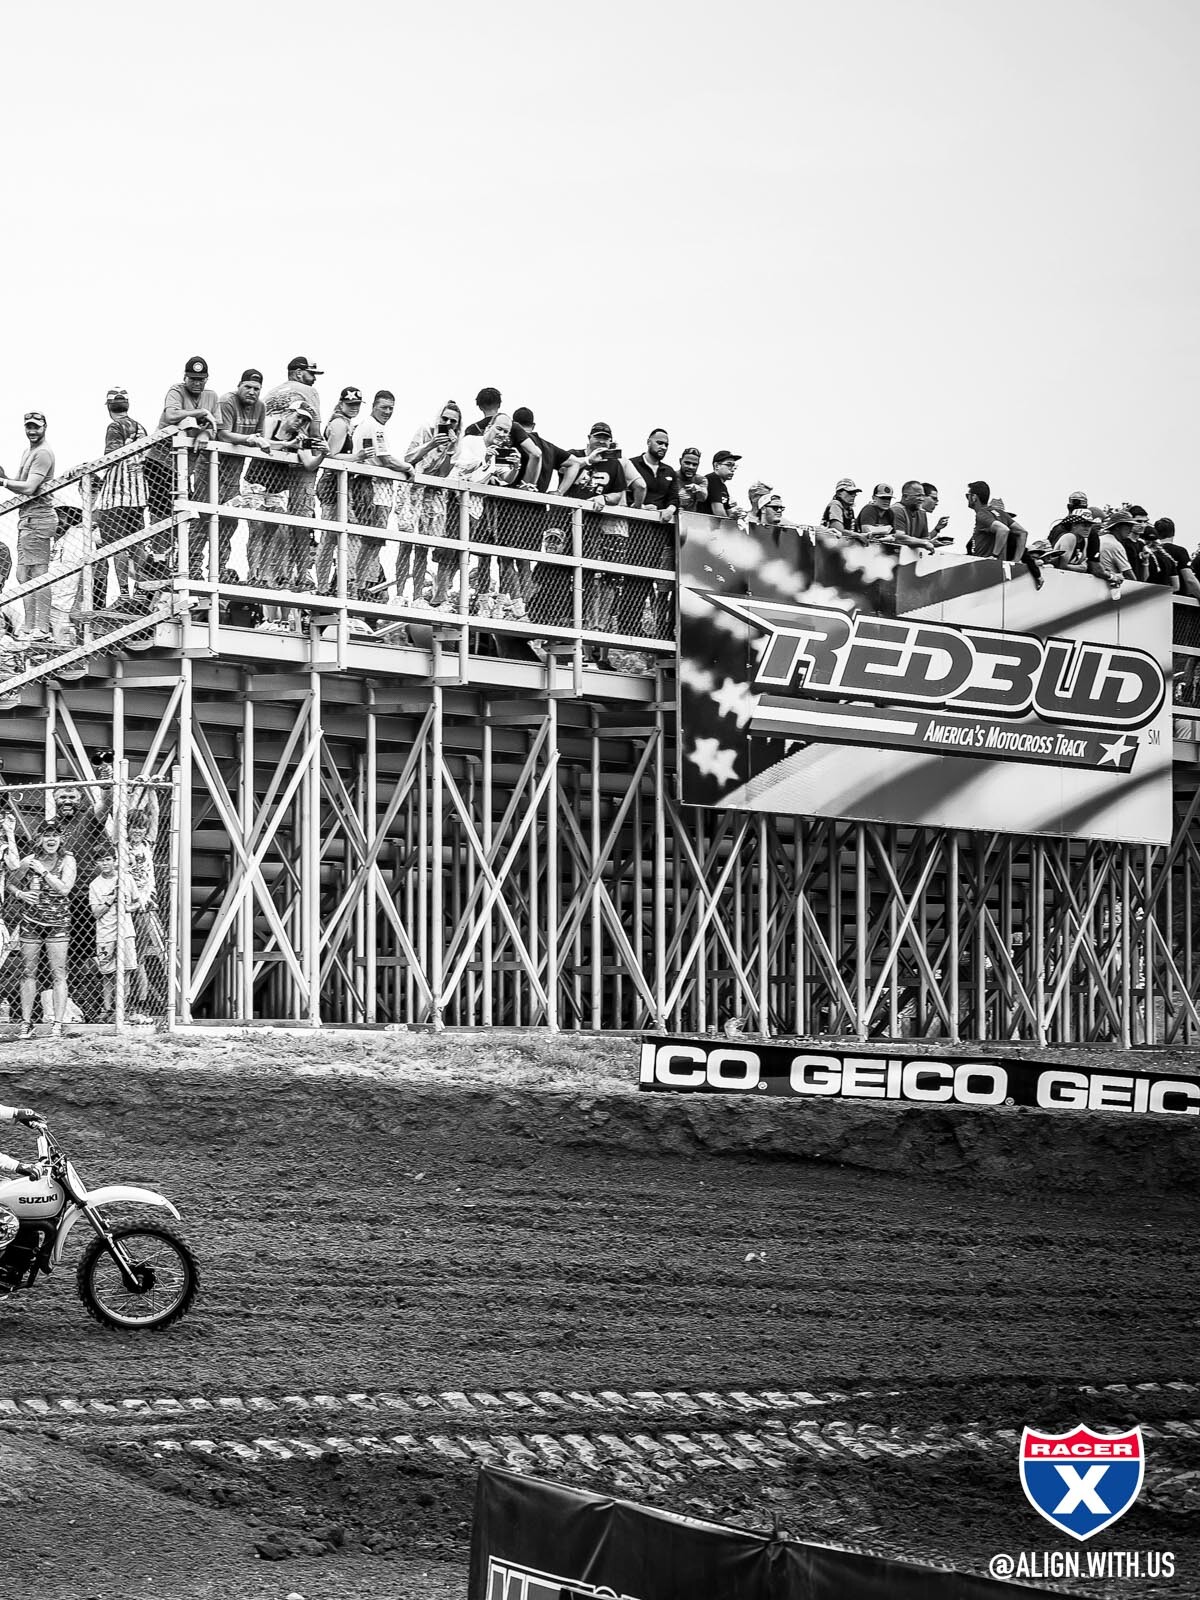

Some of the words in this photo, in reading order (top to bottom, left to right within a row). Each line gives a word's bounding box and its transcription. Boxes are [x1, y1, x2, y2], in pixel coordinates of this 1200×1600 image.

[923, 720, 985, 747] AMERICA'S
[985, 726, 1053, 755] MOTOCROSS
[1055, 733, 1089, 758] TRACK
[639, 1043, 761, 1090] ICO
[789, 1055, 1009, 1107] GEICO
[1036, 1070, 1200, 1116] GEIC
[18, 1193, 58, 1205] SUZUKI
